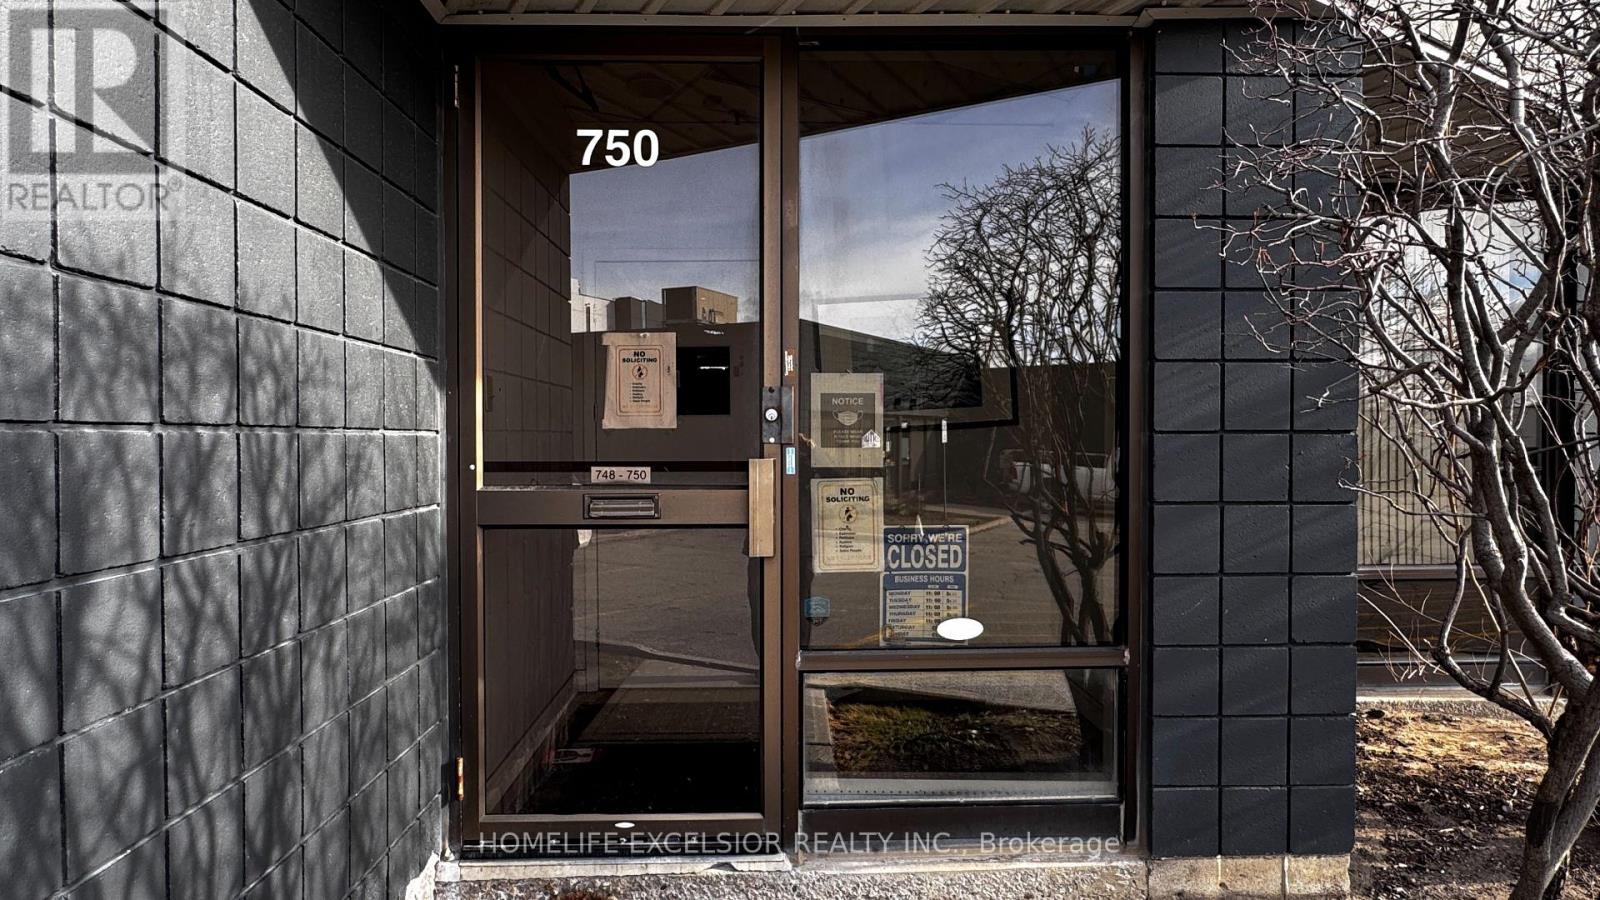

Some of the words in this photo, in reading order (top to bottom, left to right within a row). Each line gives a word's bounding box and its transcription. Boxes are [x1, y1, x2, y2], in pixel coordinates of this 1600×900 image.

[576, 129, 659, 167] 750
[832, 397, 864, 405] NOTICE
[595, 470, 615, 480] 748
[626, 470, 647, 480] 750
[927, 533, 962, 542] WE'RE
[887, 544, 963, 569] CLOSED
[894, 575, 928, 583] BUSINESS
[930, 575, 954, 583] HOURS
